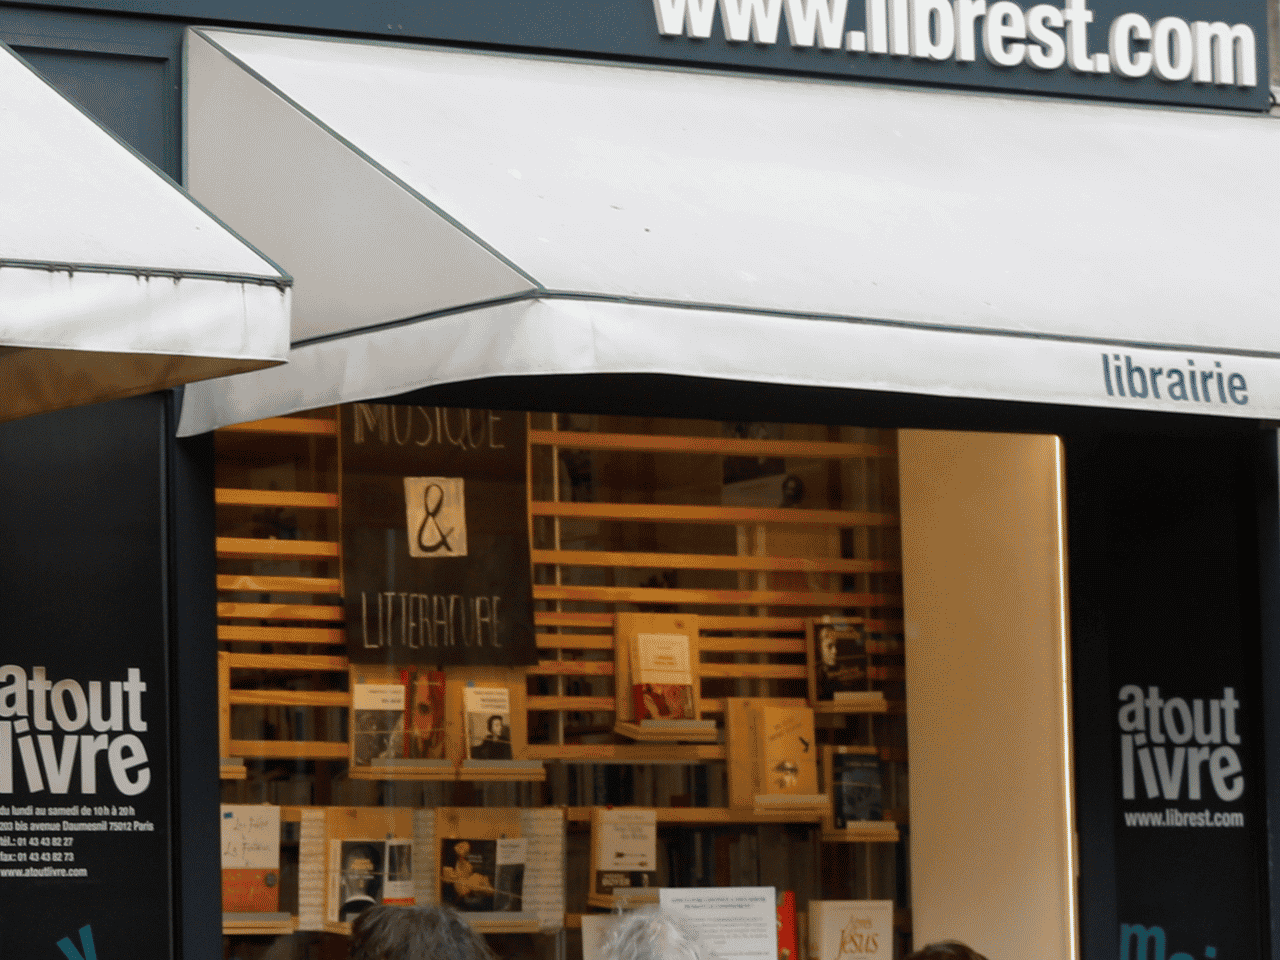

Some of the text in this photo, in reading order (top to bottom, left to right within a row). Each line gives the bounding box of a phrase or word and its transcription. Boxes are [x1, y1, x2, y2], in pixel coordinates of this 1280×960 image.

[1101, 352, 1249, 405] librairie
[1117, 684, 1241, 746] atout
[1119, 734, 1245, 803] livre
[11, 804, 33, 817] lundi
[48, 804, 79, 817] samedi
[1124, 809, 1245, 829] www.librest.com
